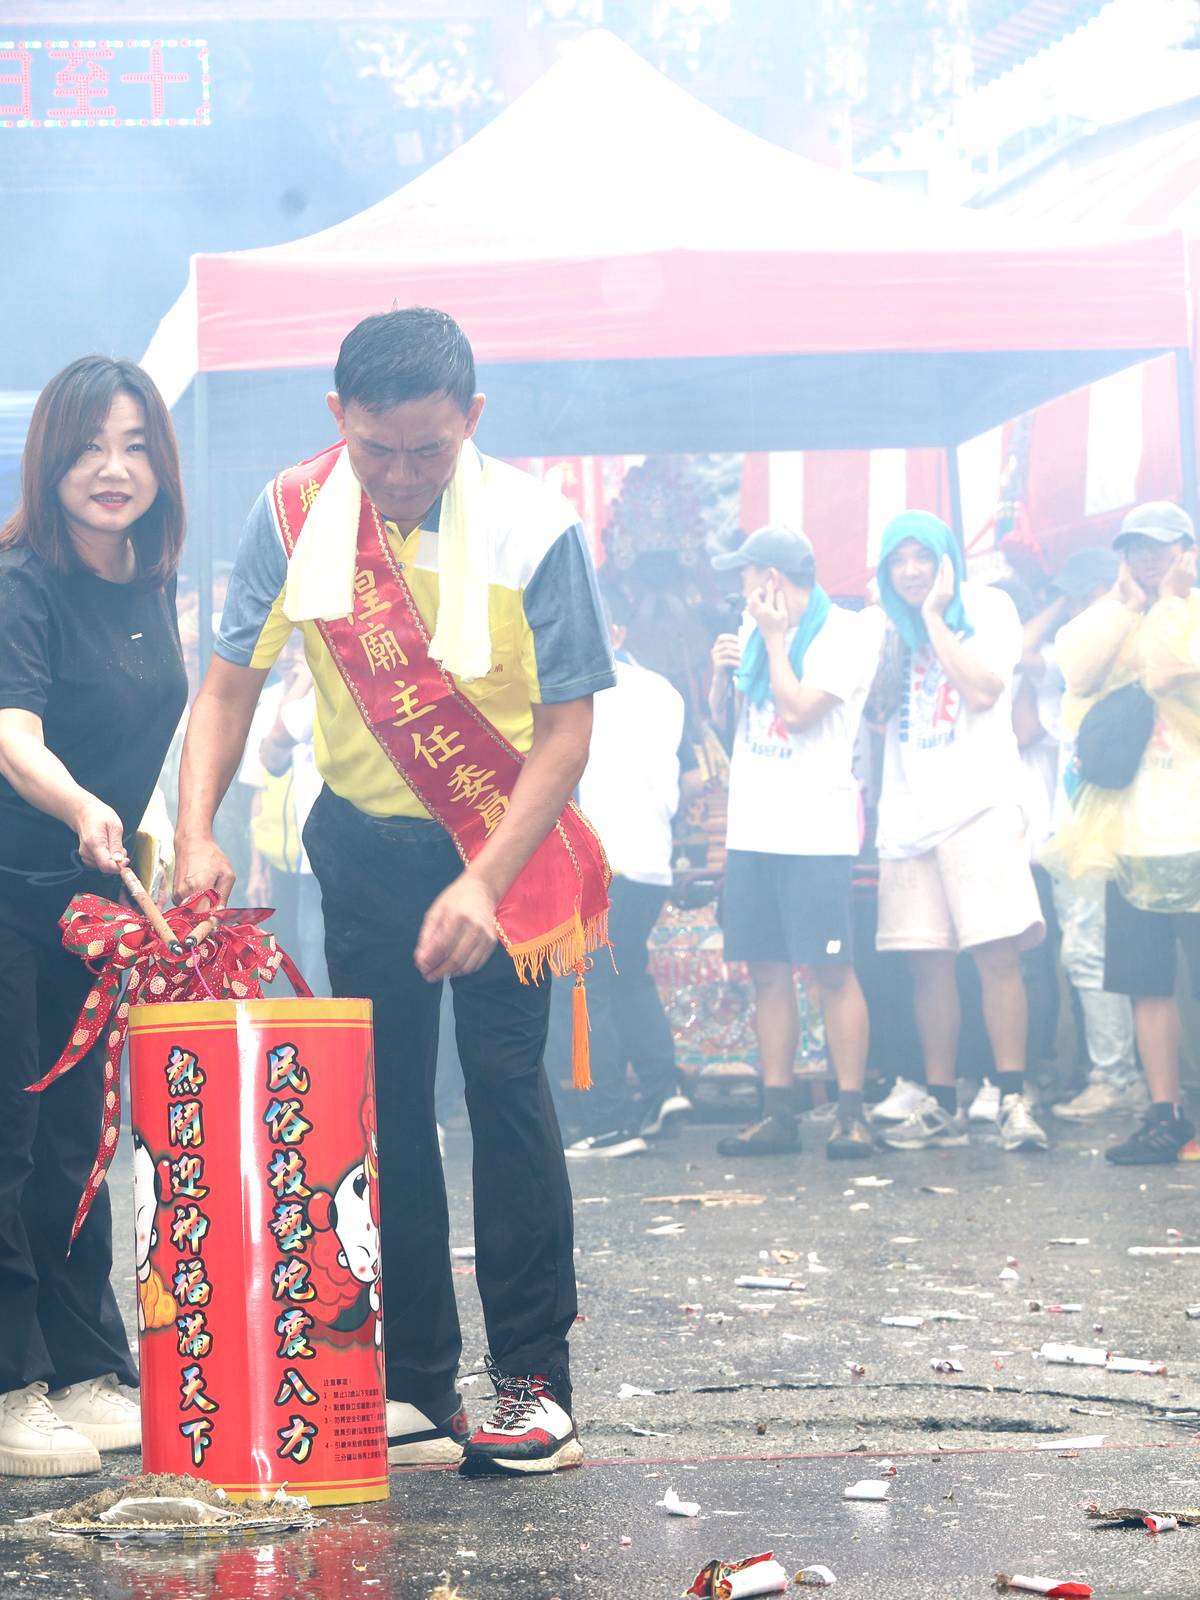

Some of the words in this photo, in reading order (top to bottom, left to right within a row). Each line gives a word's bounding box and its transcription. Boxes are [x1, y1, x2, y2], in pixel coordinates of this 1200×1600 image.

[164, 1044, 221, 1468] 熱鬧迎神福滿天下
[262, 1044, 318, 1465] 民俗技藝炮震八方
